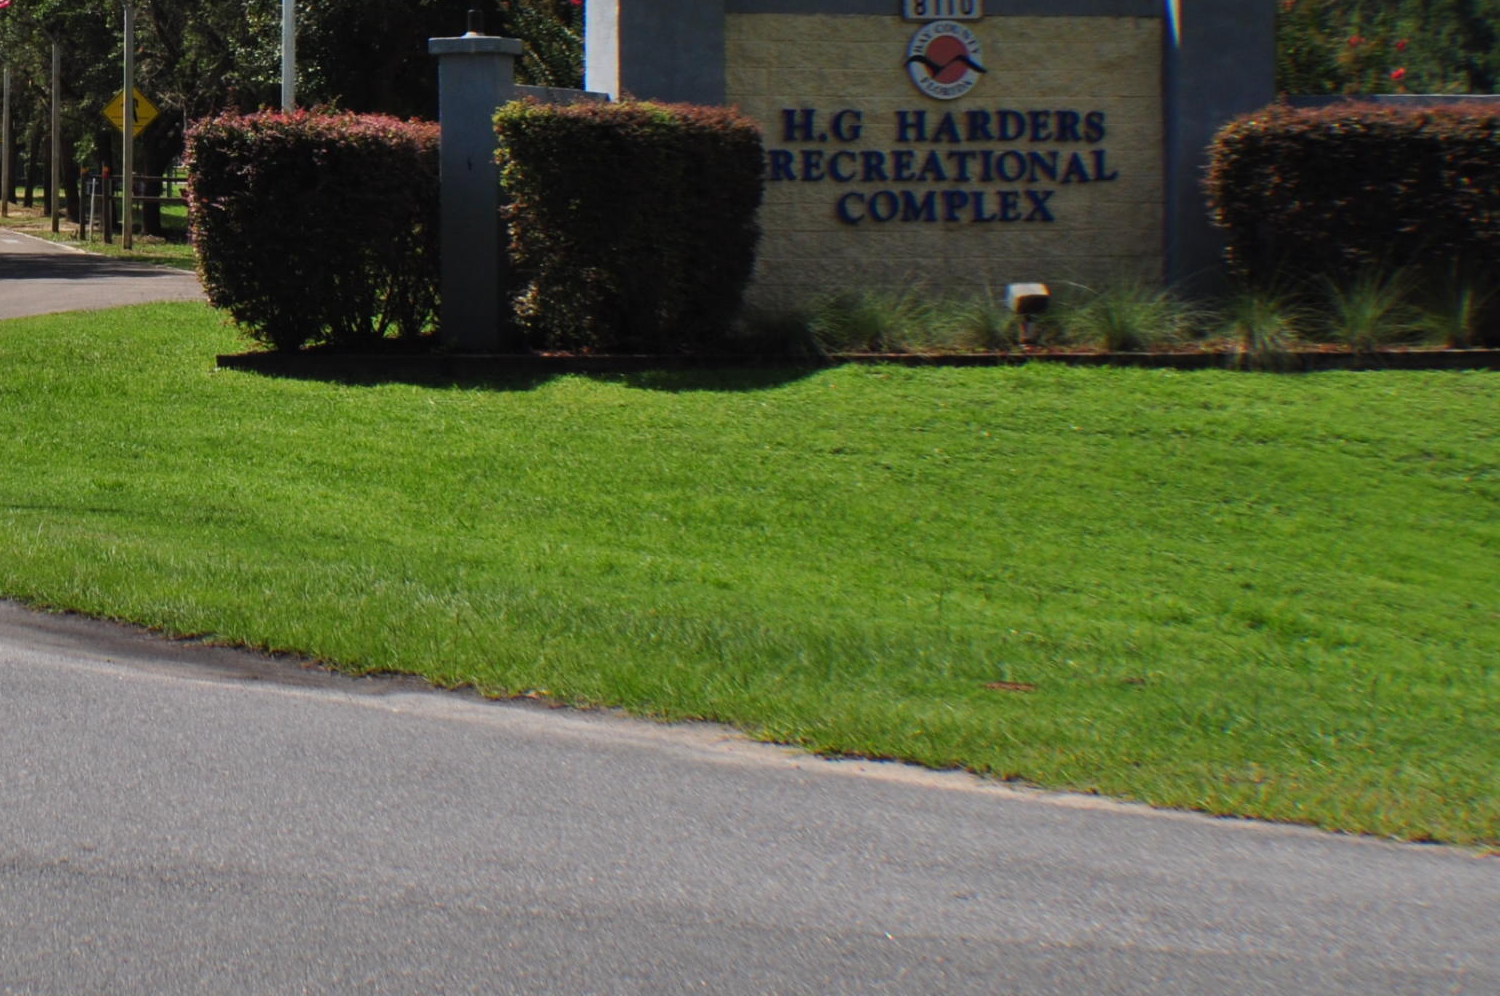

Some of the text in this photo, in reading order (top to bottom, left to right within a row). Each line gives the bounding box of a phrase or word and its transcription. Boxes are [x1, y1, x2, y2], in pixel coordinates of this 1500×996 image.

[895, 108, 1107, 144] HARDERS
[768, 148, 1119, 184] RECREATIONAL
[835, 188, 1056, 225] COMPLEX
